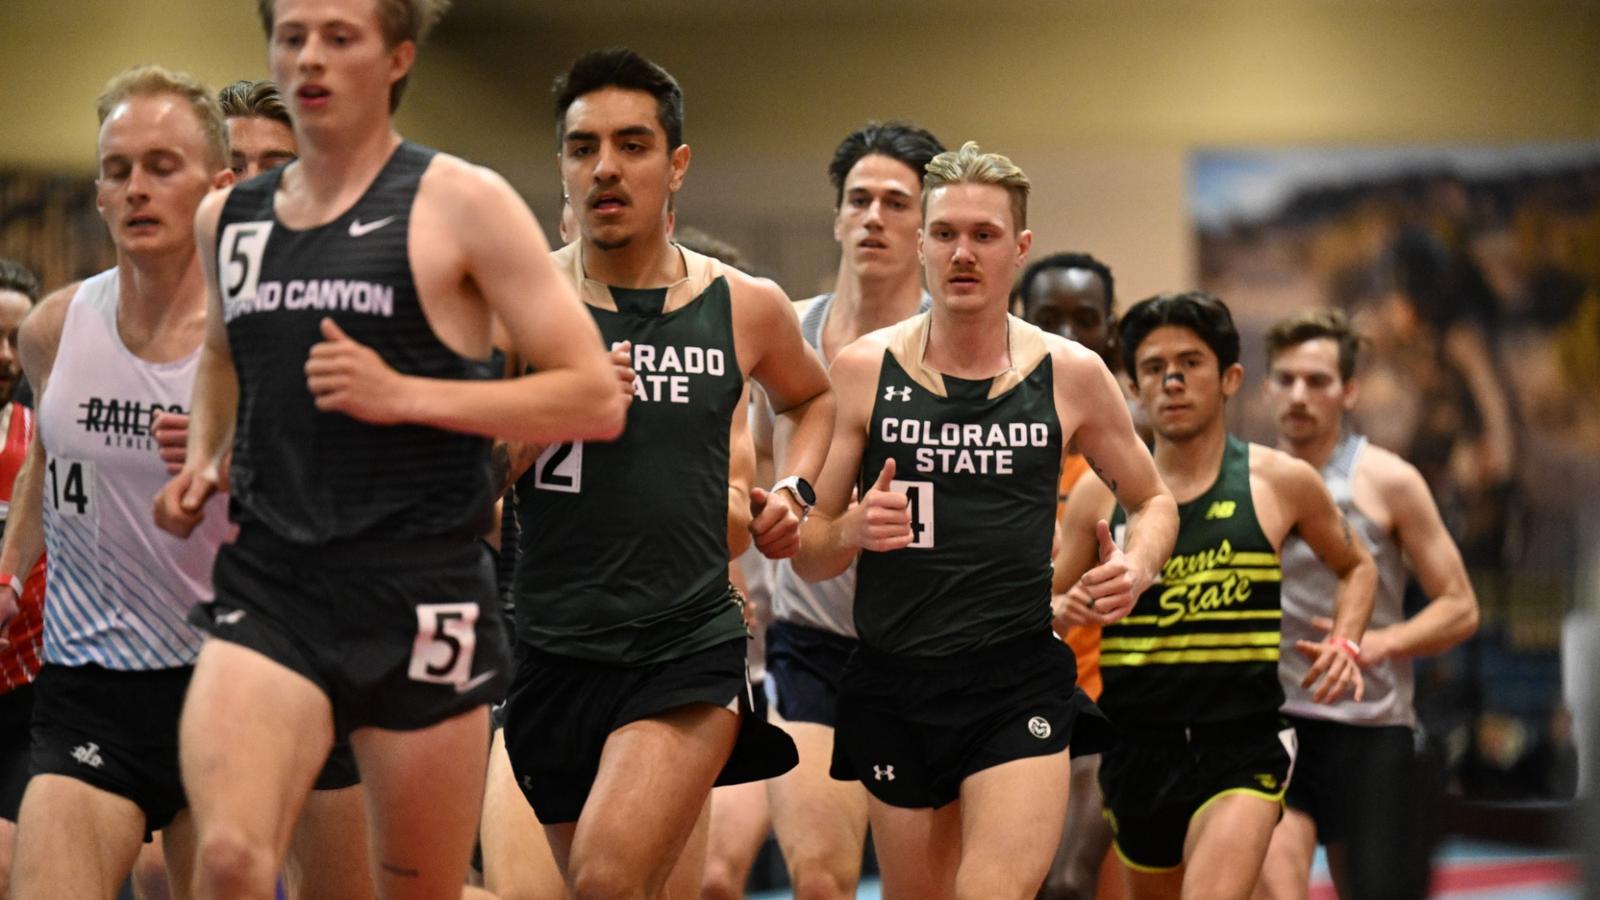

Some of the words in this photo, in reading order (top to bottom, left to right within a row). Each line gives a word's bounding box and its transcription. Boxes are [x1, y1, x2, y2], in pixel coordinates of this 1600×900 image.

[228, 229, 258, 298] 5
[284, 278, 394, 318] CANYON
[881, 417, 1048, 448] COLORADO
[48, 457, 88, 515] 14
[540, 440, 573, 487] 2
[915, 447, 1014, 475] STATE
[905, 486, 925, 544] 4
[1158, 572, 1252, 628] State
[425, 612, 463, 676] 5
